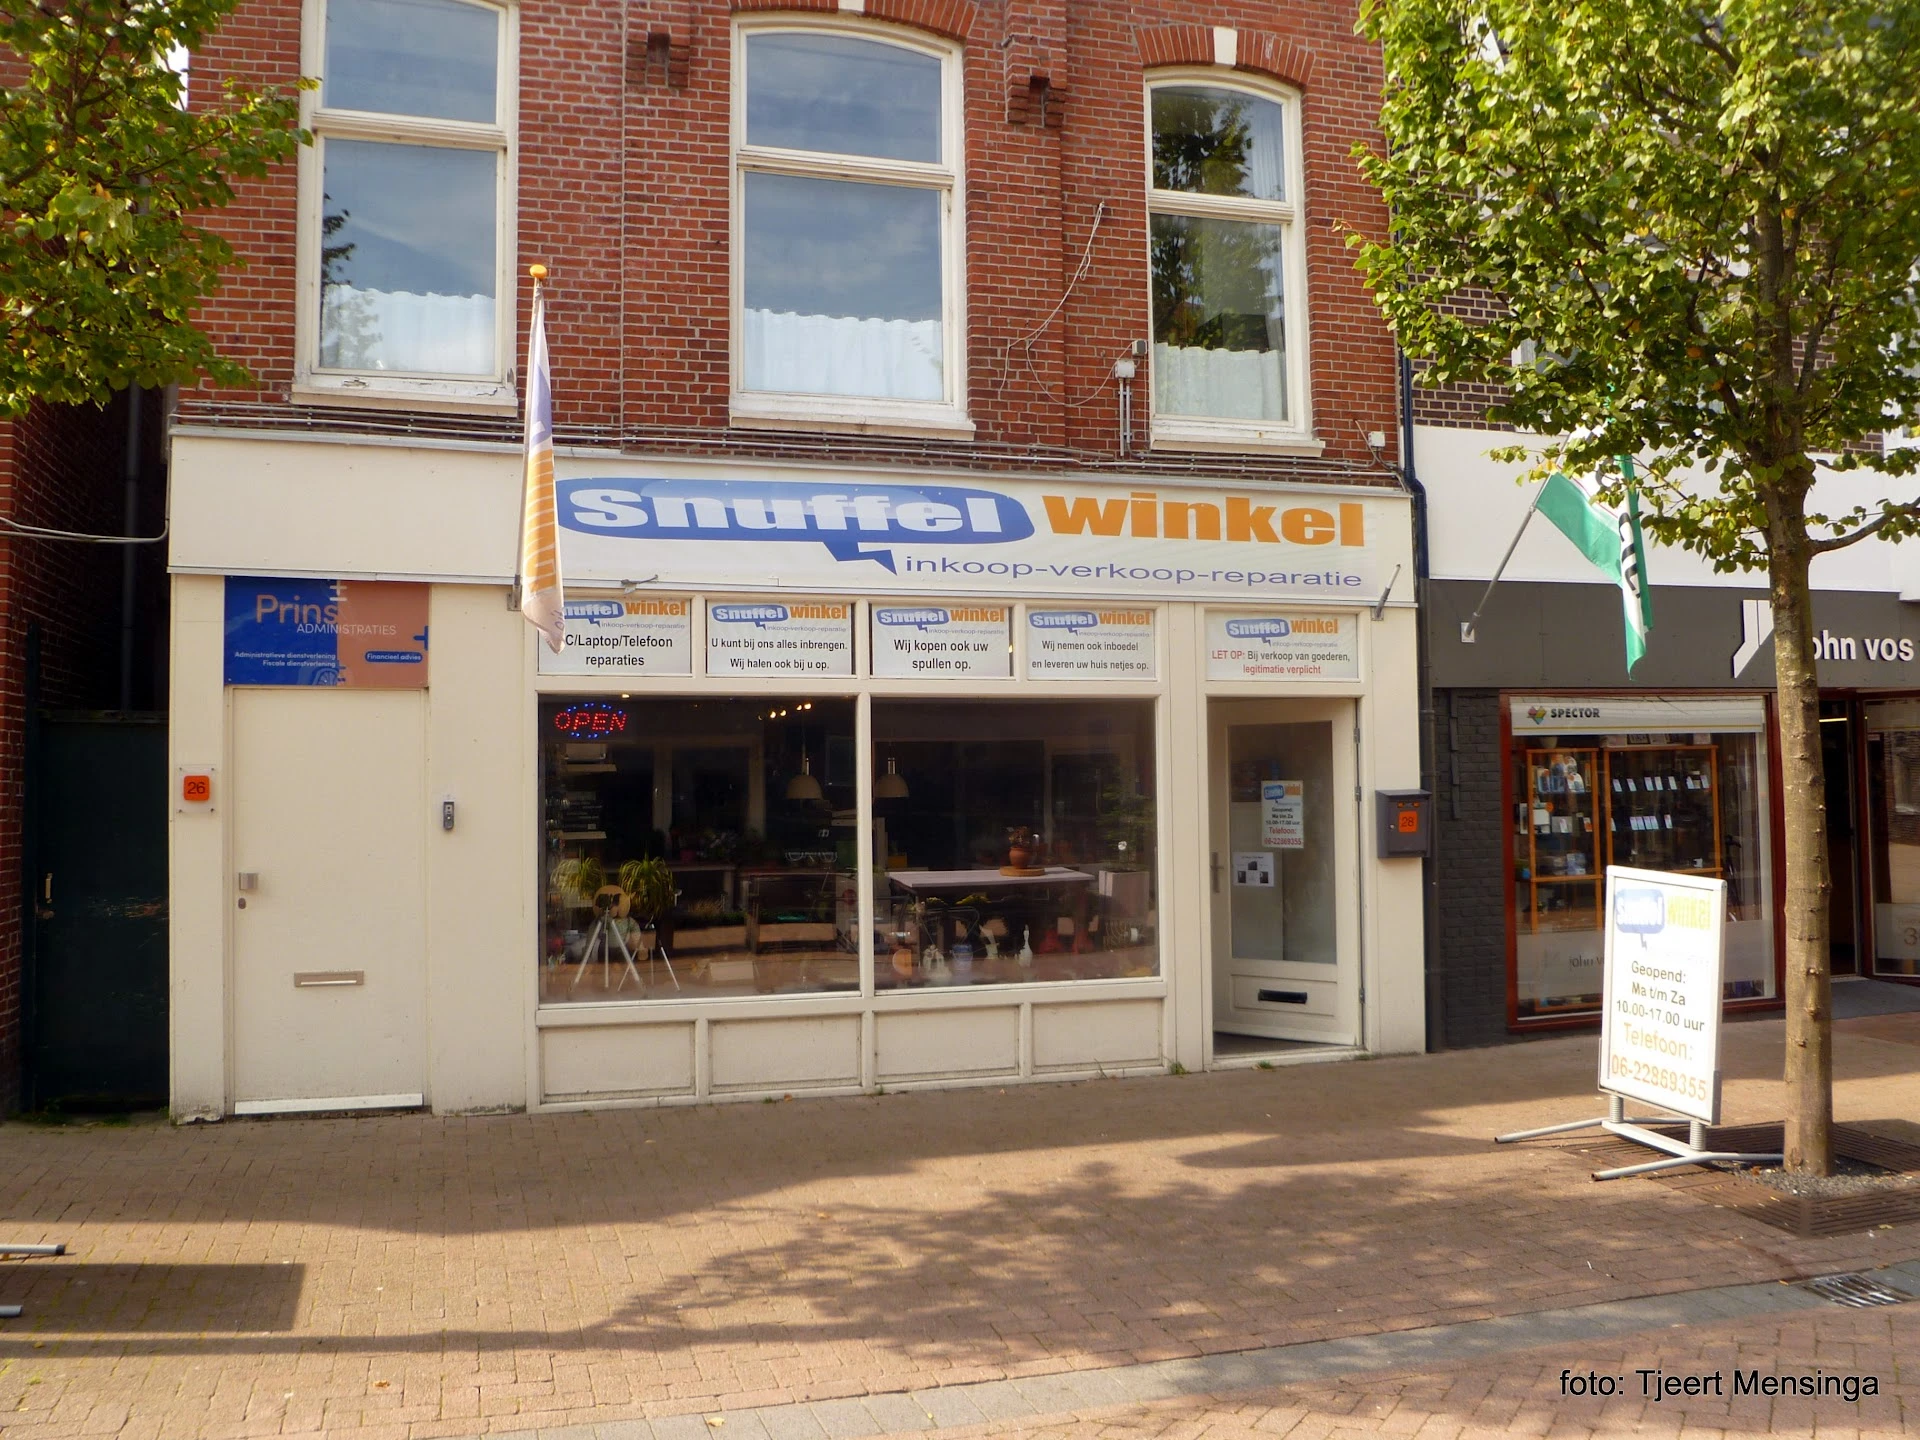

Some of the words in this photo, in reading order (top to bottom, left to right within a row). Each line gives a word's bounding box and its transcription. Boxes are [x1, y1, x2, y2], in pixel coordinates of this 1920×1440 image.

[569, 488, 1002, 533] Snuffel
[1042, 491, 1365, 547] winkel
[906, 556, 1362, 587] inkoop-verkoop-reparatie
[256, 594, 339, 624] Prins
[564, 603, 619, 617] nuffel
[625, 600, 686, 616] winkel
[716, 607, 784, 620] Snuffel
[790, 603, 847, 620] winkel
[880, 610, 945, 623] Snuffel
[950, 607, 1005, 622] winkel
[1032, 613, 1094, 626] Snuffel
[1099, 609, 1150, 625] winkel
[296, 623, 397, 635] ADMINISTRATIES
[602, 621, 685, 630] inkoop-verkoop-reparatie
[1228, 620, 1286, 635] Snuffel
[1290, 618, 1338, 634] winkel
[565, 634, 673, 649] C/Laptop/Telefoon
[711, 638, 719, 648] U
[721, 638, 742, 648] kunt
[744, 638, 755, 651] bij
[757, 641, 774, 649] ons
[777, 639, 798, 649] alles
[800, 639, 848, 652] inbrengen.
[894, 639, 911, 653] Wij
[914, 640, 947, 653] kopen
[950, 640, 970, 652] ook
[973, 643, 989, 652] uw
[1042, 640, 1055, 651] Wij
[1057, 642, 1085, 651] nemen
[1087, 642, 1102, 651] ook
[1104, 641, 1139, 651] inboedel
[1812, 629, 1856, 660] ohn
[1864, 638, 1914, 661] vos
[234, 651, 285, 660] Administratieve
[286, 652, 336, 661] dienstverlening
[400, 653, 422, 661] advies
[585, 654, 645, 668] reparaties
[1212, 650, 1229, 660] LET
[1230, 650, 1246, 660] OP:
[1248, 651, 1259, 662] Bij
[1260, 651, 1293, 662] verkoop
[1295, 652, 1309, 661] van
[1311, 652, 1351, 663] goederen,
[262, 660, 285, 668] Fiscale
[286, 660, 336, 669] dienstverlening
[730, 658, 745, 670] Wij
[747, 658, 772, 669] halen
[774, 658, 791, 669] ook
[794, 659, 805, 671] bij
[807, 661, 813, 669] u
[815, 661, 830, 671] op.
[912, 658, 951, 671] spullen
[955, 661, 972, 672] op.
[1031, 661, 1042, 669] en
[1044, 660, 1074, 669] leveren
[1076, 661, 1088, 669] uw
[1090, 660, 1108, 670] huis
[1110, 660, 1134, 671] netjes
[1136, 662, 1149, 672] op.
[1243, 664, 1285, 675] legitimatie
[1286, 665, 1321, 676] verplicht
[1550, 707, 1601, 718] SPECTOR
[554, 712, 627, 731] OPEN
[187, 781, 206, 795] 26
[1401, 816, 1414, 828] 28
[1268, 827, 1297, 835] Telefoon:
[1631, 960, 1686, 984] Geopend:
[1632, 982, 1647, 997] Ma
[1649, 986, 1668, 1002] t/m
[1670, 989, 1686, 1006] Za
[1616, 999, 1680, 1027] 10.00-17.00
[1683, 1018, 1705, 1032] uur
[1623, 1021, 1694, 1061] Telefoon:
[1611, 1054, 1708, 1102] 06-22869355
